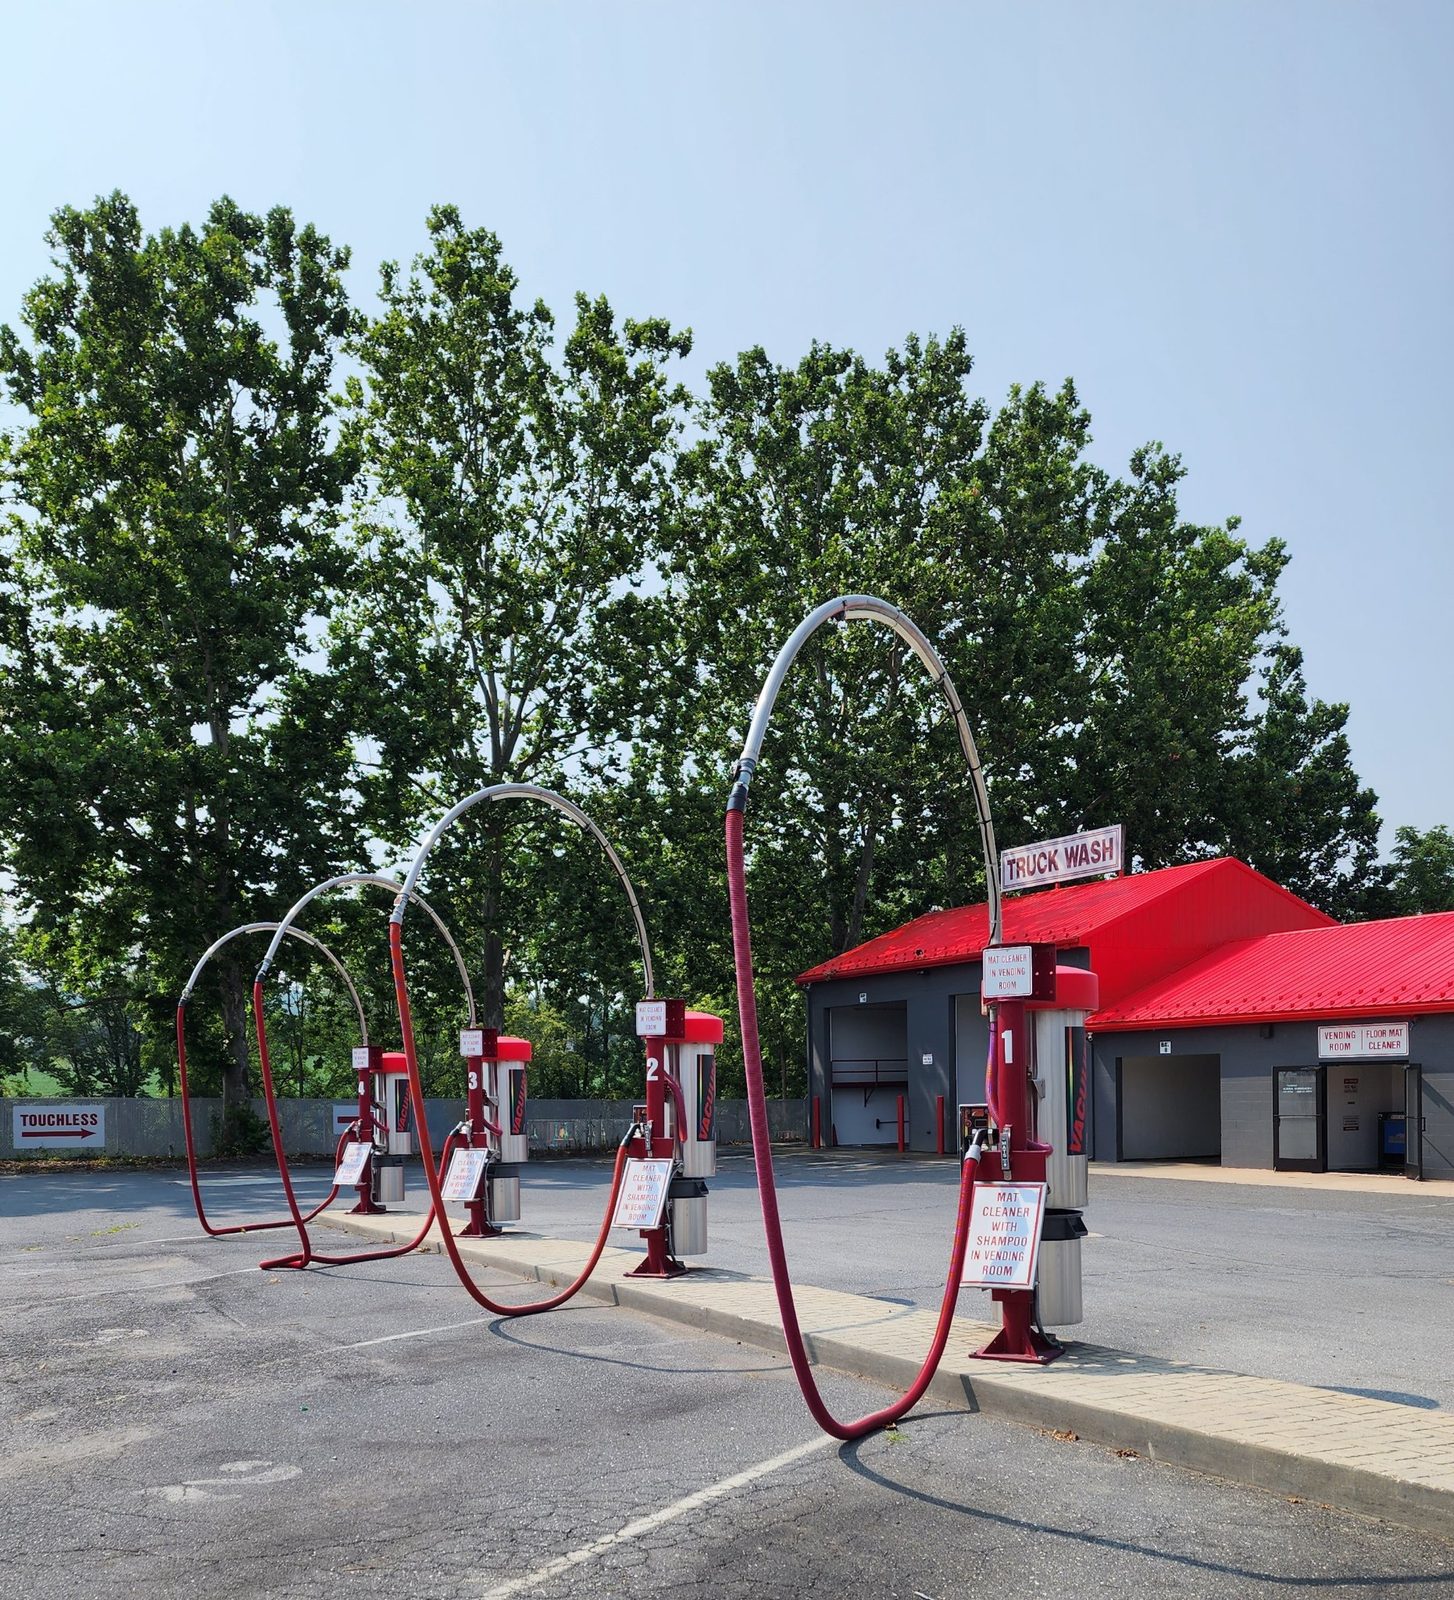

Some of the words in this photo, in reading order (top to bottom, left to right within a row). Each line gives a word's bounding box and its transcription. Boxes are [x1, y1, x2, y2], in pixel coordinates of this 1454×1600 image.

[1007, 849, 1059, 880] TRUCK
[1065, 837, 1114, 868] WASH
[988, 955, 999, 964] MAT
[1002, 953, 1027, 963] CLEANER
[990, 968, 996, 977] IN
[998, 967, 1026, 977] VENDING
[998, 981, 1017, 989] ROOM
[1324, 1030, 1356, 1039] VENDING
[1366, 1029, 1387, 1038] FLOOR
[1389, 1028, 1403, 1037] MAT
[1001, 1029, 1013, 1064] 1
[1329, 1042, 1351, 1051] ROOM
[1368, 1040, 1401, 1050] CLEANER
[646, 1057, 658, 1080] 2
[468, 1071, 477, 1089] 3
[358, 1080, 365, 1095] 4
[1071, 1042, 1087, 1152] VACU
[20, 1113, 98, 1126] TOUCHLESS
[997, 1192, 1019, 1202] MAT
[983, 1206, 1030, 1217] CLEANER
[992, 1221, 1018, 1232] WITH
[977, 1235, 1027, 1246] SHAMPOO
[971, 1250, 980, 1260] IN
[984, 1250, 1024, 1261] VENDING
[982, 1265, 1013, 1276] ROOM
